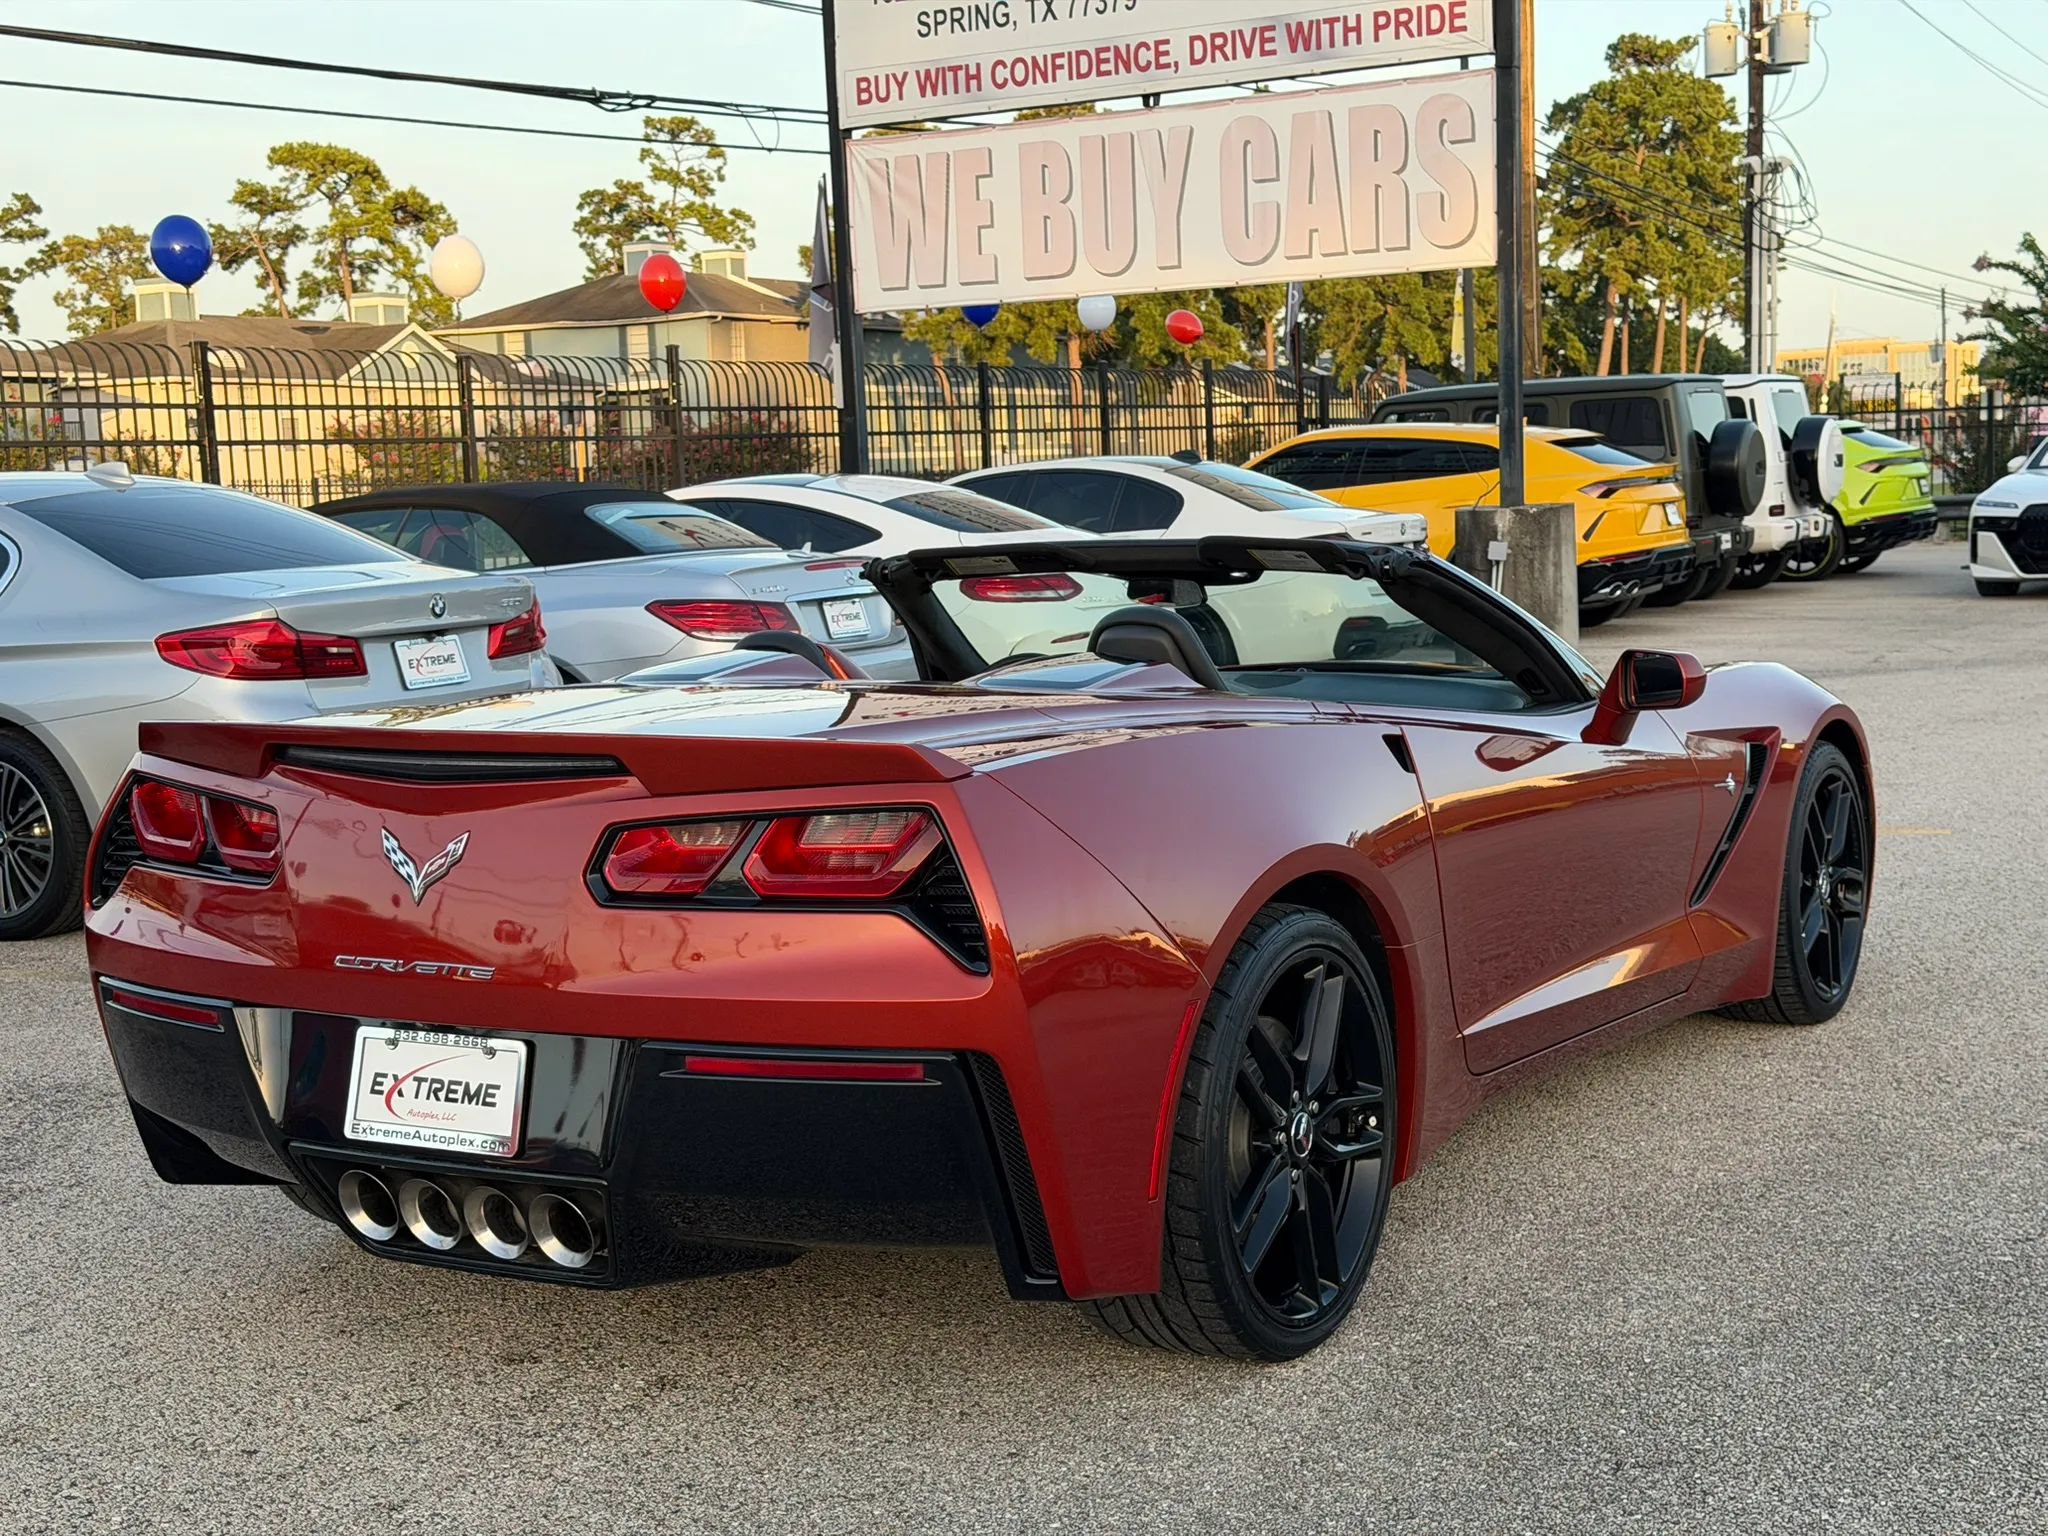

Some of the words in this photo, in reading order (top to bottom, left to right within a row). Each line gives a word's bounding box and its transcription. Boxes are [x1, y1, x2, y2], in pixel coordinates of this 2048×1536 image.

[917, 0, 1018, 38] SPRING,
[1025, 0, 1059, 24] TX
[856, 71, 909, 106] BUY
[915, 62, 982, 98] WITH
[990, 38, 1180, 90] CONFIDENCE,
[1189, 25, 1277, 66] DRIVE
[1285, 14, 1362, 53] WITH
[1373, 1, 1468, 43] PRIDE
[866, 146, 999, 292] WE
[1018, 125, 1194, 281] BUY
[1218, 93, 1478, 267] CARS
[831, 611, 862, 623] EXTREME
[407, 653, 457, 670] EXTREME
[334, 955, 496, 980] CORVETTE
[369, 1072, 502, 1108] EXTREME
[441, 1112, 457, 1122] LLC
[351, 1122, 510, 1152] ExtremeAutoplex.com
